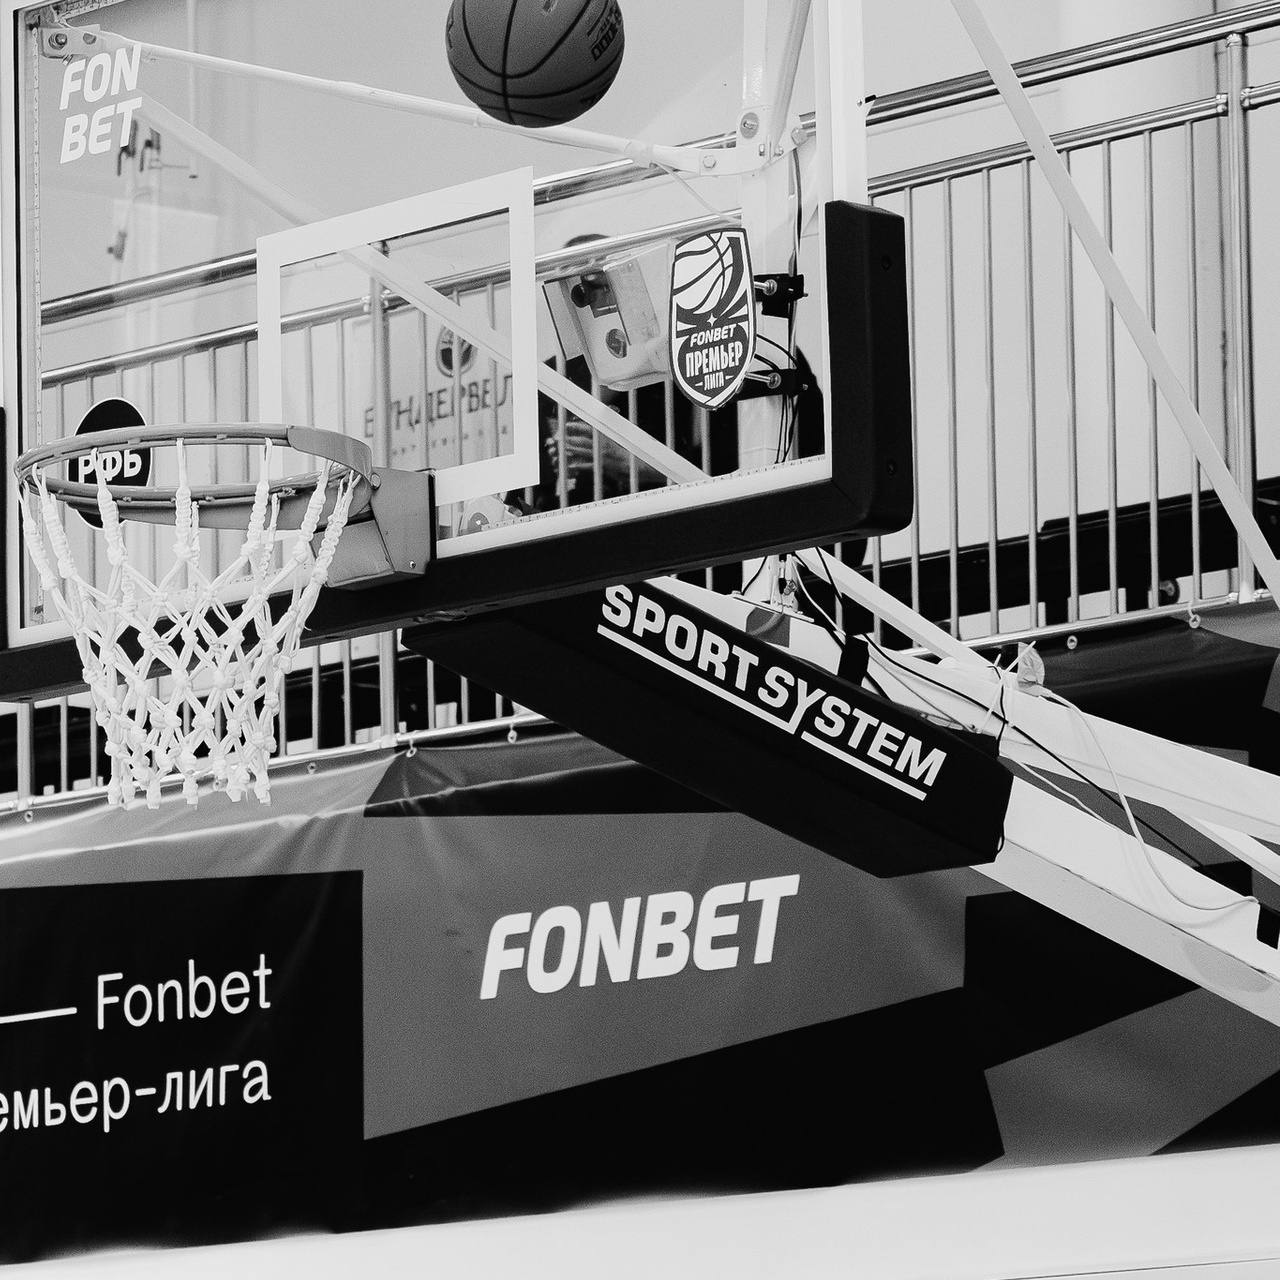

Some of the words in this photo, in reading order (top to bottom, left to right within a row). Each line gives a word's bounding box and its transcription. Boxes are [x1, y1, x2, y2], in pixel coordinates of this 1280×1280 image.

[59, 43, 142, 110] FON
[59, 96, 142, 164] BET
[685, 341, 743, 378] ПРЕМЬЕР
[690, 323, 737, 347] FONBET
[704, 371, 725, 391] ЛИГА
[601, 584, 759, 692] SPORT
[757, 665, 947, 787] SYSTEM
[480, 873, 799, 1000] FONBET
[96, 954, 273, 1030] Fonbet
